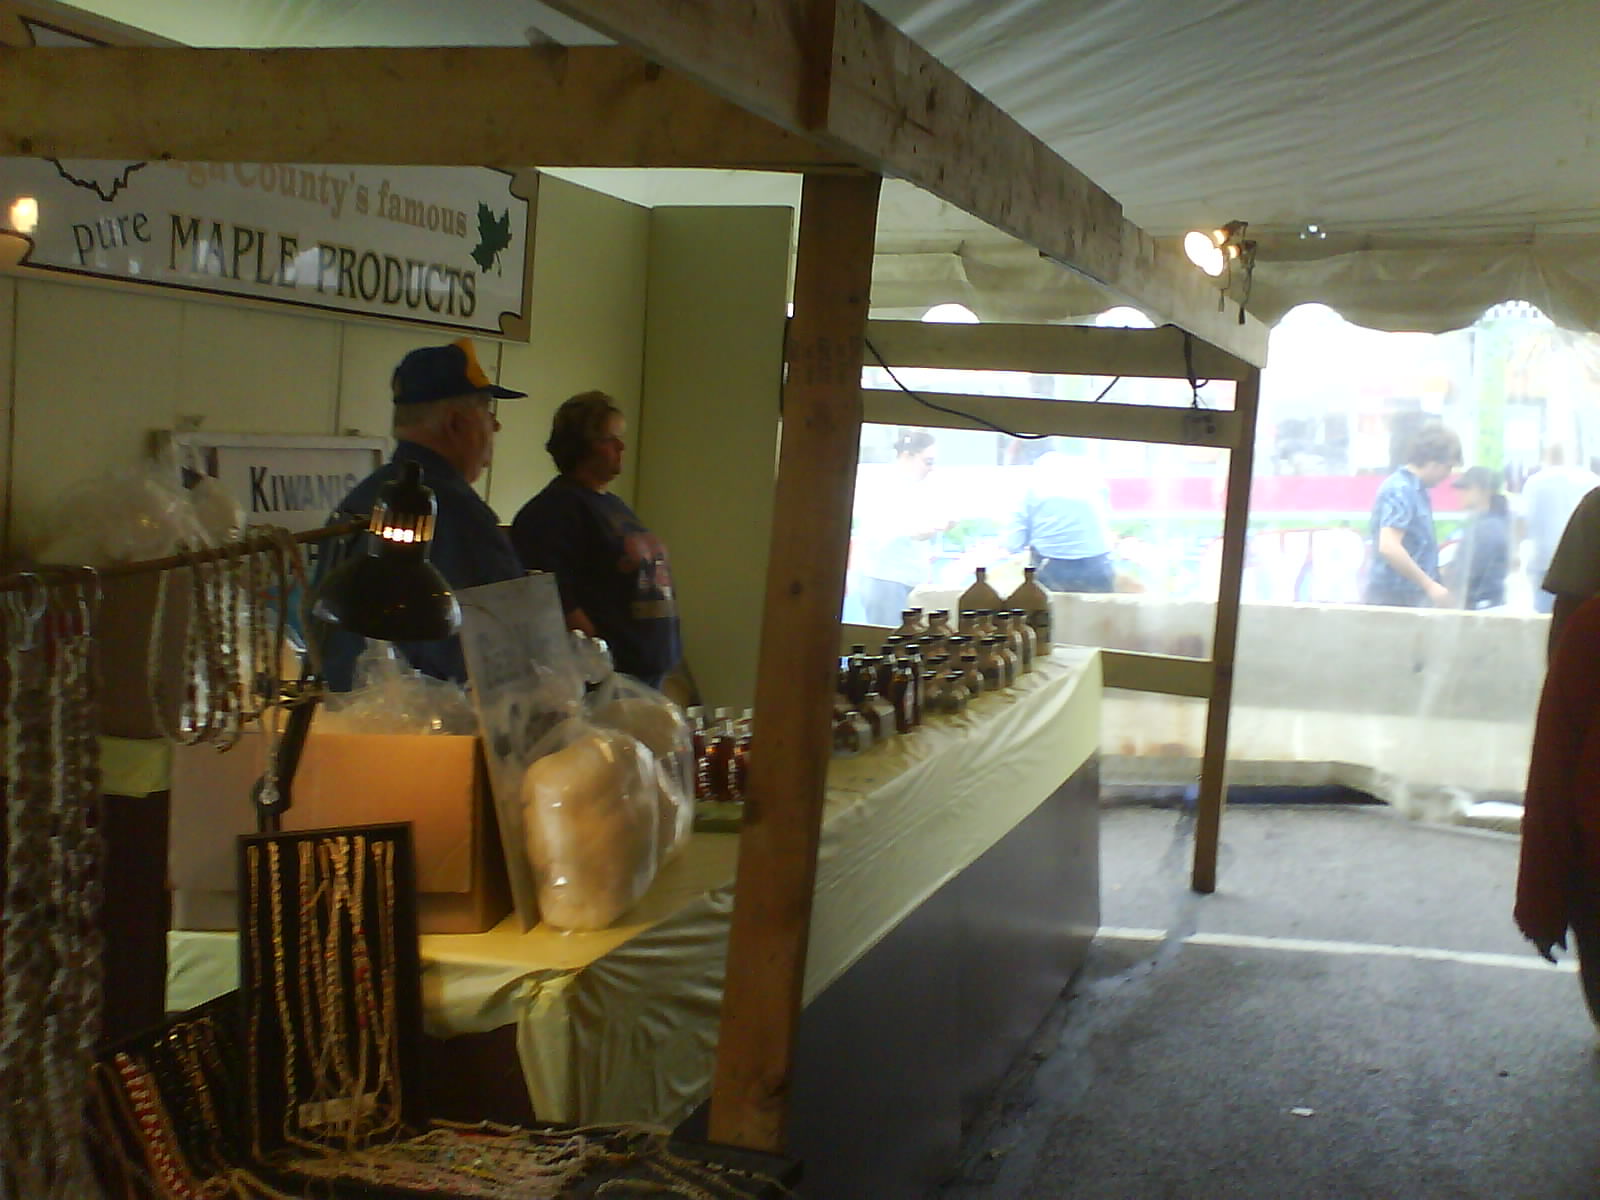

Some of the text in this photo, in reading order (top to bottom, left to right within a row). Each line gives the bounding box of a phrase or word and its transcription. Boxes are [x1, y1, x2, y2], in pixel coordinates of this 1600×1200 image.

[234, 162, 368, 218] County's
[377, 180, 466, 238] famous
[72, 211, 476, 318] pure MAPLE PRODUCTS
